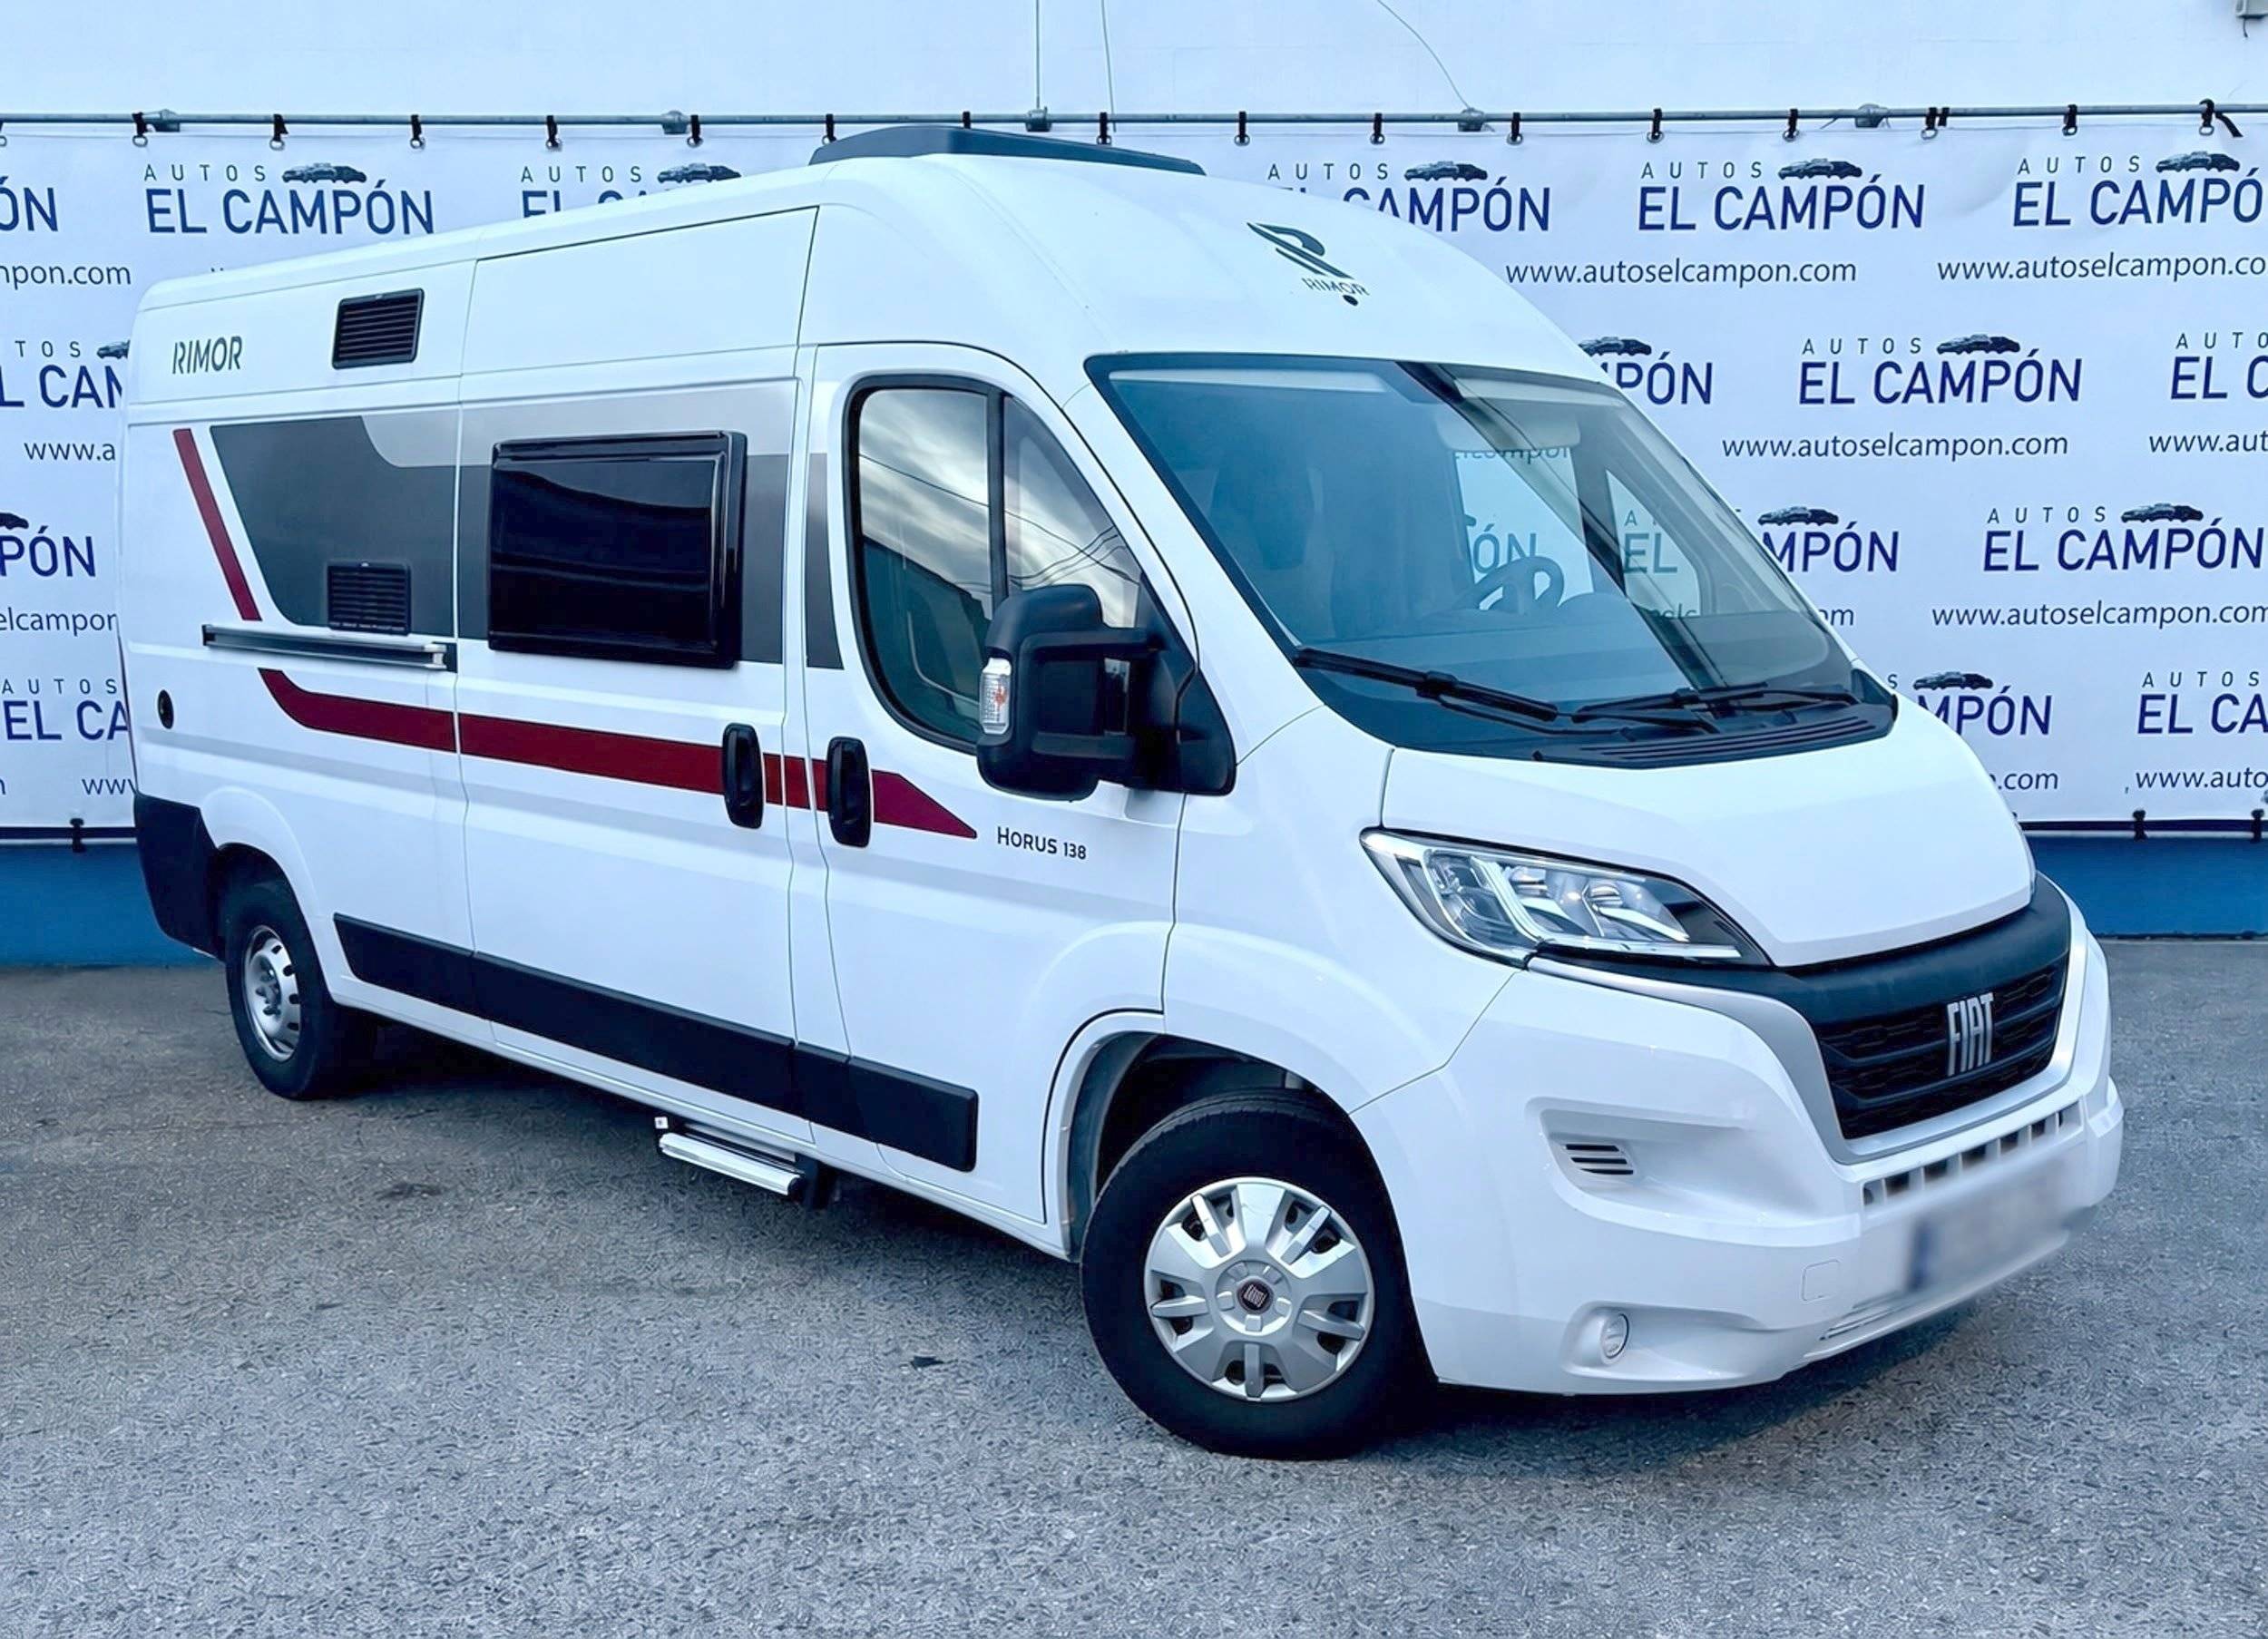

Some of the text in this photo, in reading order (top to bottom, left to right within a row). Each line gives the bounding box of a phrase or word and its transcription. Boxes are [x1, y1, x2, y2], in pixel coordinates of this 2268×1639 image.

[143, 163, 267, 182] AUTOS
[521, 165, 642, 183] AUTOS
[1267, 162, 1389, 180] AUTOS
[1640, 161, 1762, 180] AUTOS
[2017, 154, 2140, 175] AUTOS
[145, 179, 435, 235] EL CAMPÓN
[1638, 173, 1925, 231] EL CAMPÓN
[2013, 180, 2071, 227] EL
[1505, 257, 1856, 288] www.autoselcampon.com
[172, 336, 243, 375] RIMOR
[1802, 337, 1921, 355] AUTOS
[1799, 348, 2082, 405] EL CAMPÓN
[2170, 356, 2228, 400] EL
[1722, 432, 2068, 463] www.autoselcampon.com
[1987, 505, 2106, 524] AUTOS
[1983, 516, 2264, 571] EL CAMPÓN
[2, 678, 118, 695] AUTOS
[2141, 670, 2260, 688] AUTOS
[3, 700, 63, 741] EL
[2137, 694, 2194, 735] EL
[997, 825, 1087, 860] HORUS 138
[1947, 992, 1994, 1077] FIAT
